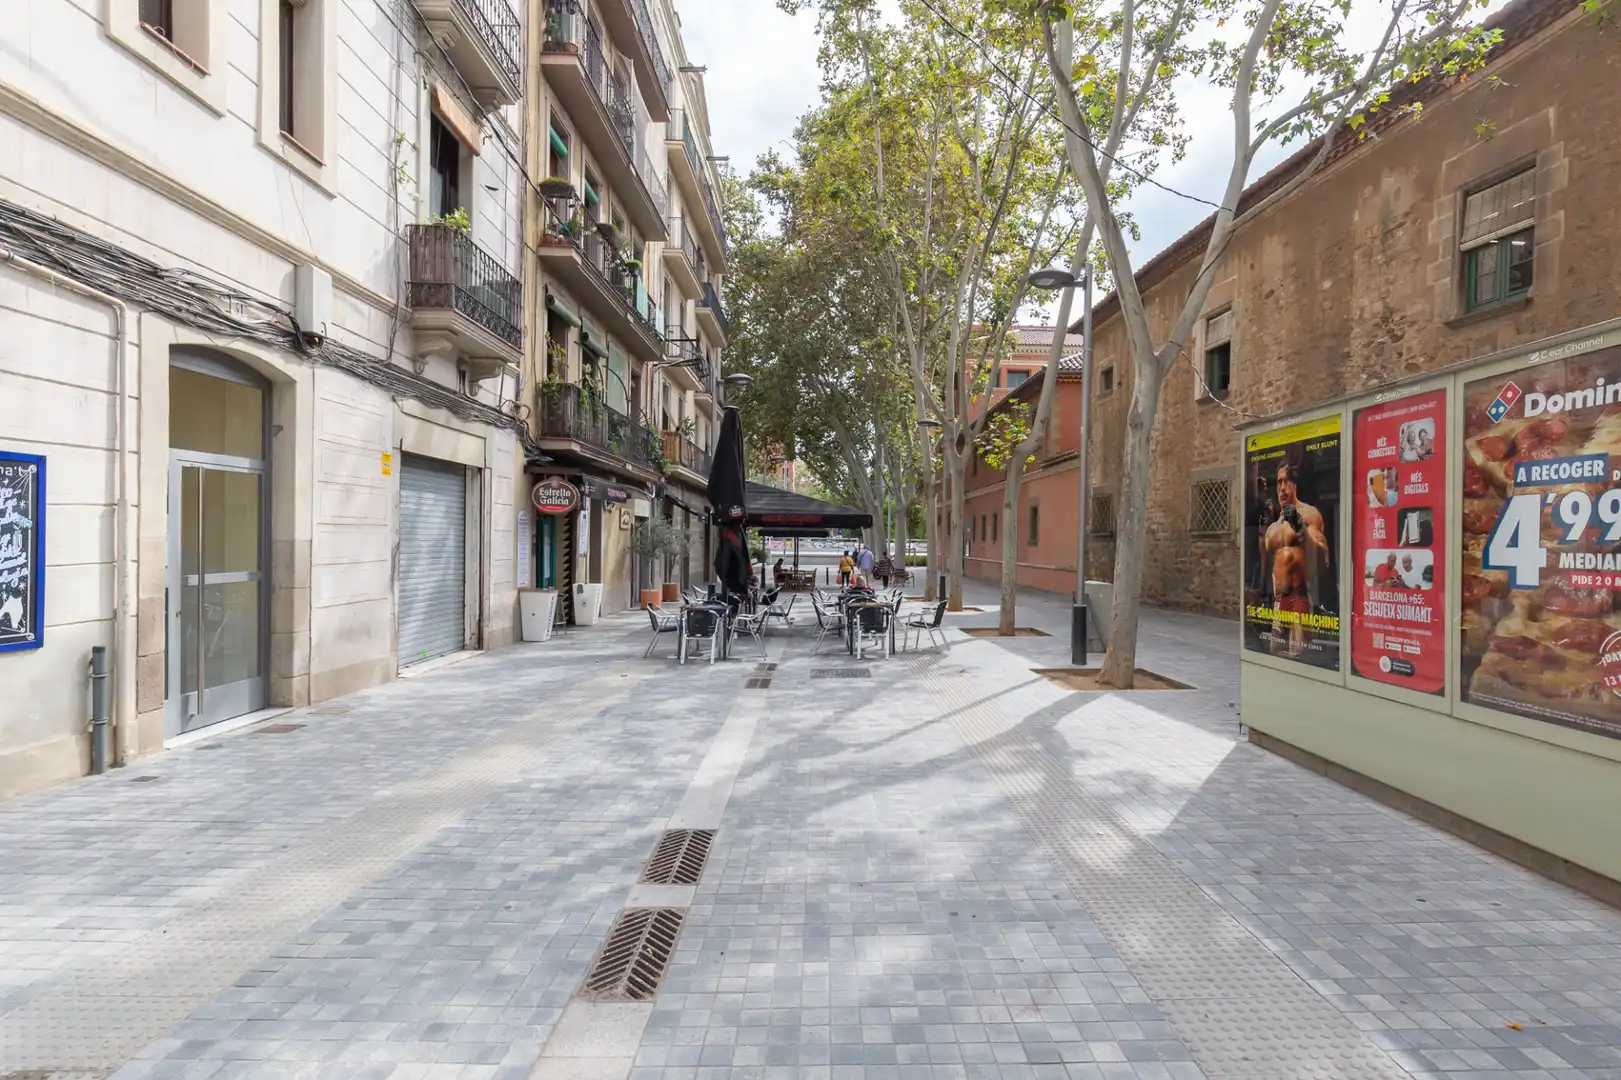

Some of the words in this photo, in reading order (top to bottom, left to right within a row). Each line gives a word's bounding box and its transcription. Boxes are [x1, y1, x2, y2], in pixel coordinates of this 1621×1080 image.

[1540, 347, 1563, 359] Cear
[1565, 335, 1604, 353] Channel
[1524, 377, 1621, 418] Domin
[1306, 442, 1320, 452] EMILY
[1321, 440, 1338, 449] BLUNT
[1410, 470, 1423, 483] MÉS
[1516, 467, 1527, 482] A
[1531, 460, 1605, 481] RECOGER
[539, 487, 571, 497] Estrella
[540, 496, 569, 505] Galicia
[1572, 575, 1593, 585] PIDE
[1595, 577, 1602, 585] 2
[1369, 590, 1408, 604] BARCELONA
[1409, 594, 1425, 605] +65:
[1257, 607, 1300, 624] SMASHING
[1302, 613, 1340, 630] MACHINE
[1364, 601, 1395, 619] SEGUEIX
[1396, 604, 1432, 623] SUMANT
[1604, 675, 1617, 687] 13
